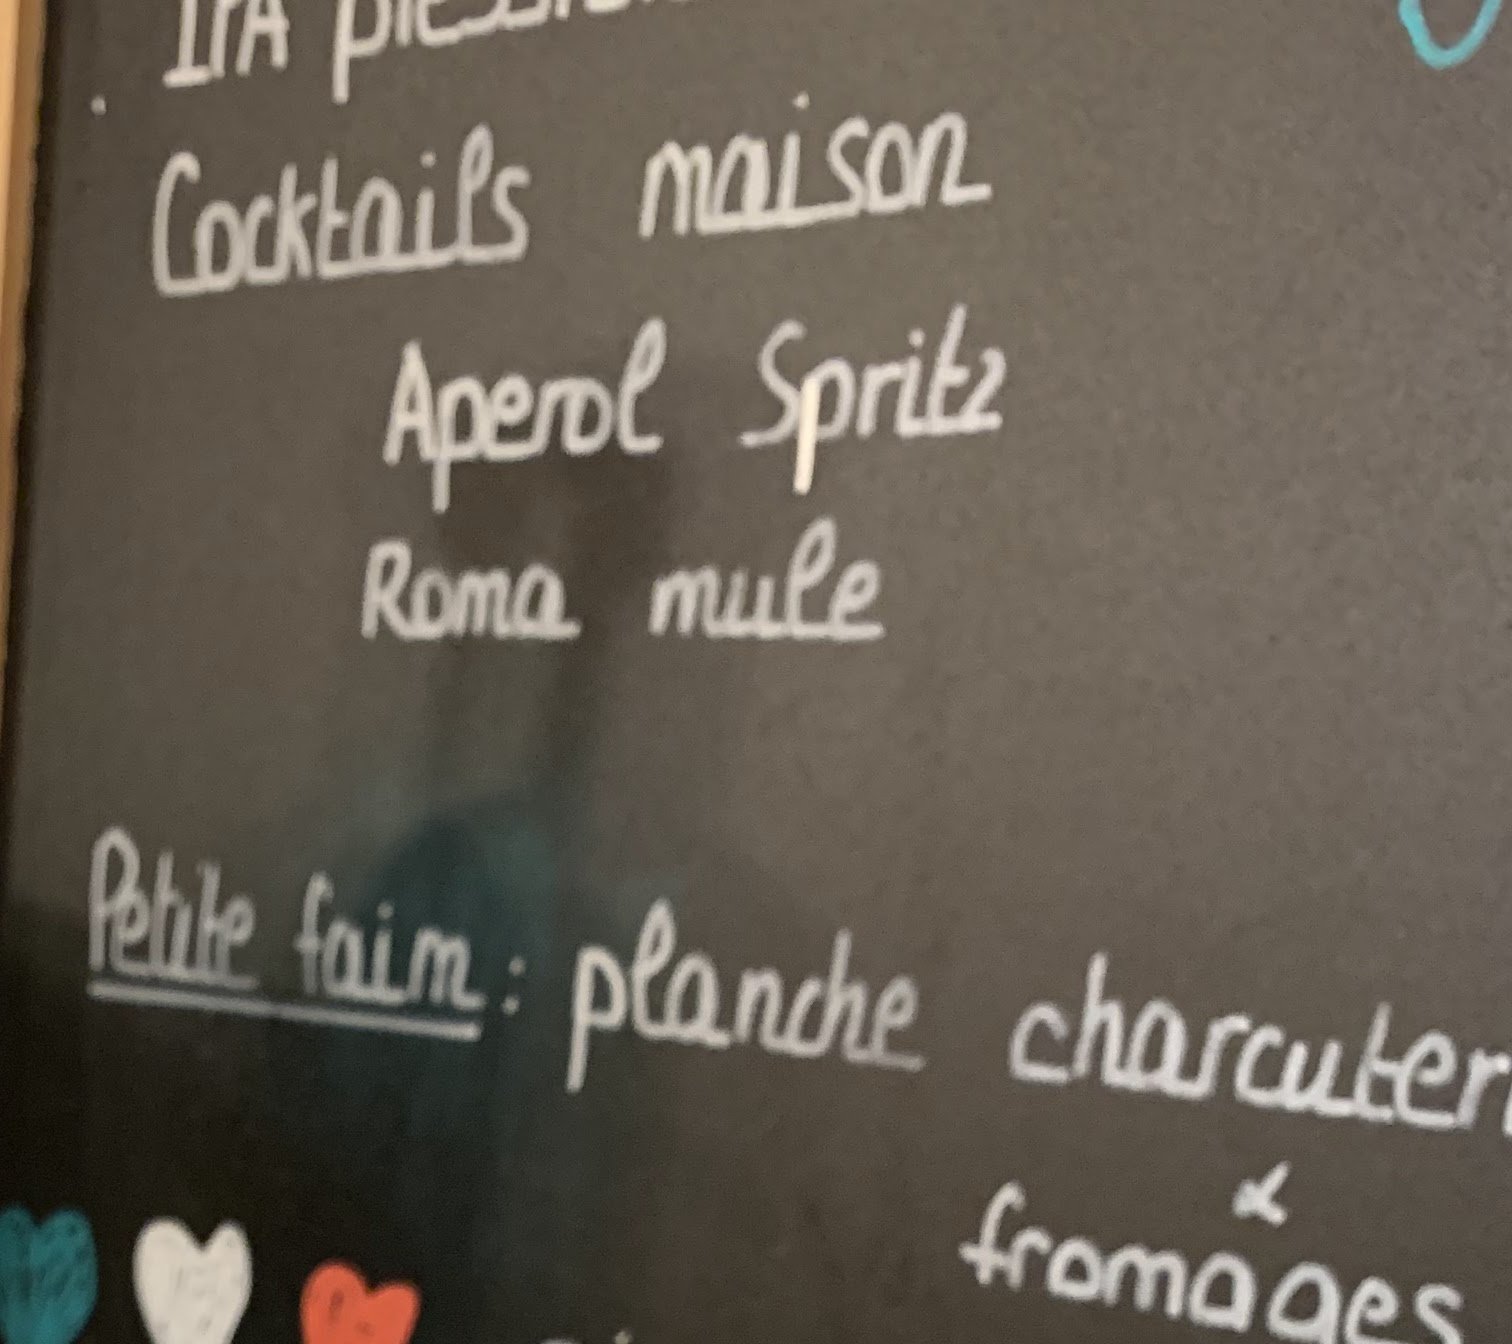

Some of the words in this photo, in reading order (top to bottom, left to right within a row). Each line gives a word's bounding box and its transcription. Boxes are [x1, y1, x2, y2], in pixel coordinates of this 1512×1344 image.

[152, 124, 531, 297] Cocktails
[637, 92, 994, 238] maison
[382, 316, 668, 513] Aperol
[738, 302, 1008, 496] Spritz
[359, 538, 582, 642] Roma
[648, 516, 886, 643] mule
[88, 825, 260, 990] Petite
[565, 897, 926, 1094] planche
